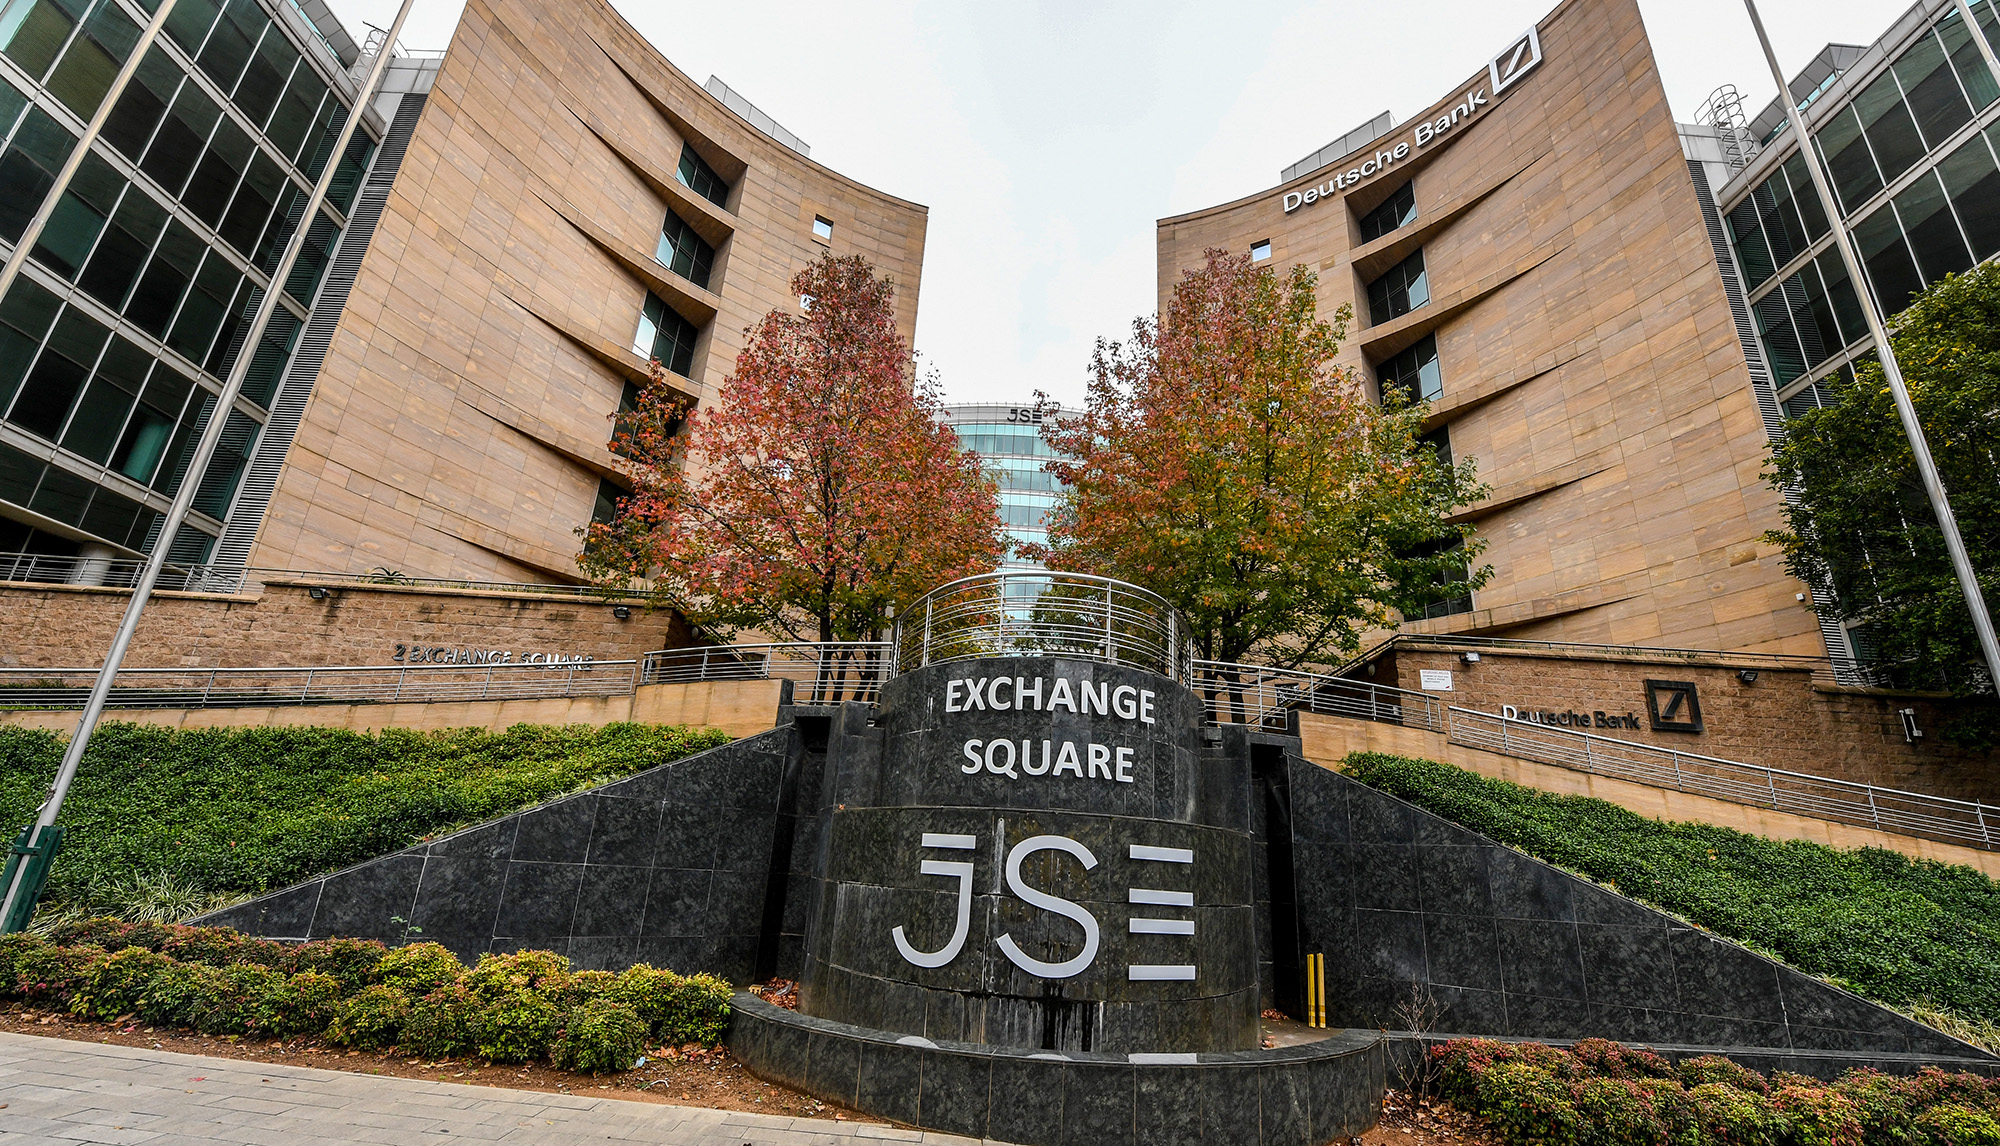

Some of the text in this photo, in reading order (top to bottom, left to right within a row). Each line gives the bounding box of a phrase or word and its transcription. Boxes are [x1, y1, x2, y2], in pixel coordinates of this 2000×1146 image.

[1282, 88, 1489, 214] Deutsche Bank
[1007, 408, 1042, 423] JSE
[392, 643, 594, 671] 2 EXCHANGE SQUARE
[945, 676, 1156, 724] EXCHANGE
[1502, 704, 1641, 730] Deutsche Bank
[961, 738, 1135, 783] SQUARE
[891, 832, 1196, 981] JSE
